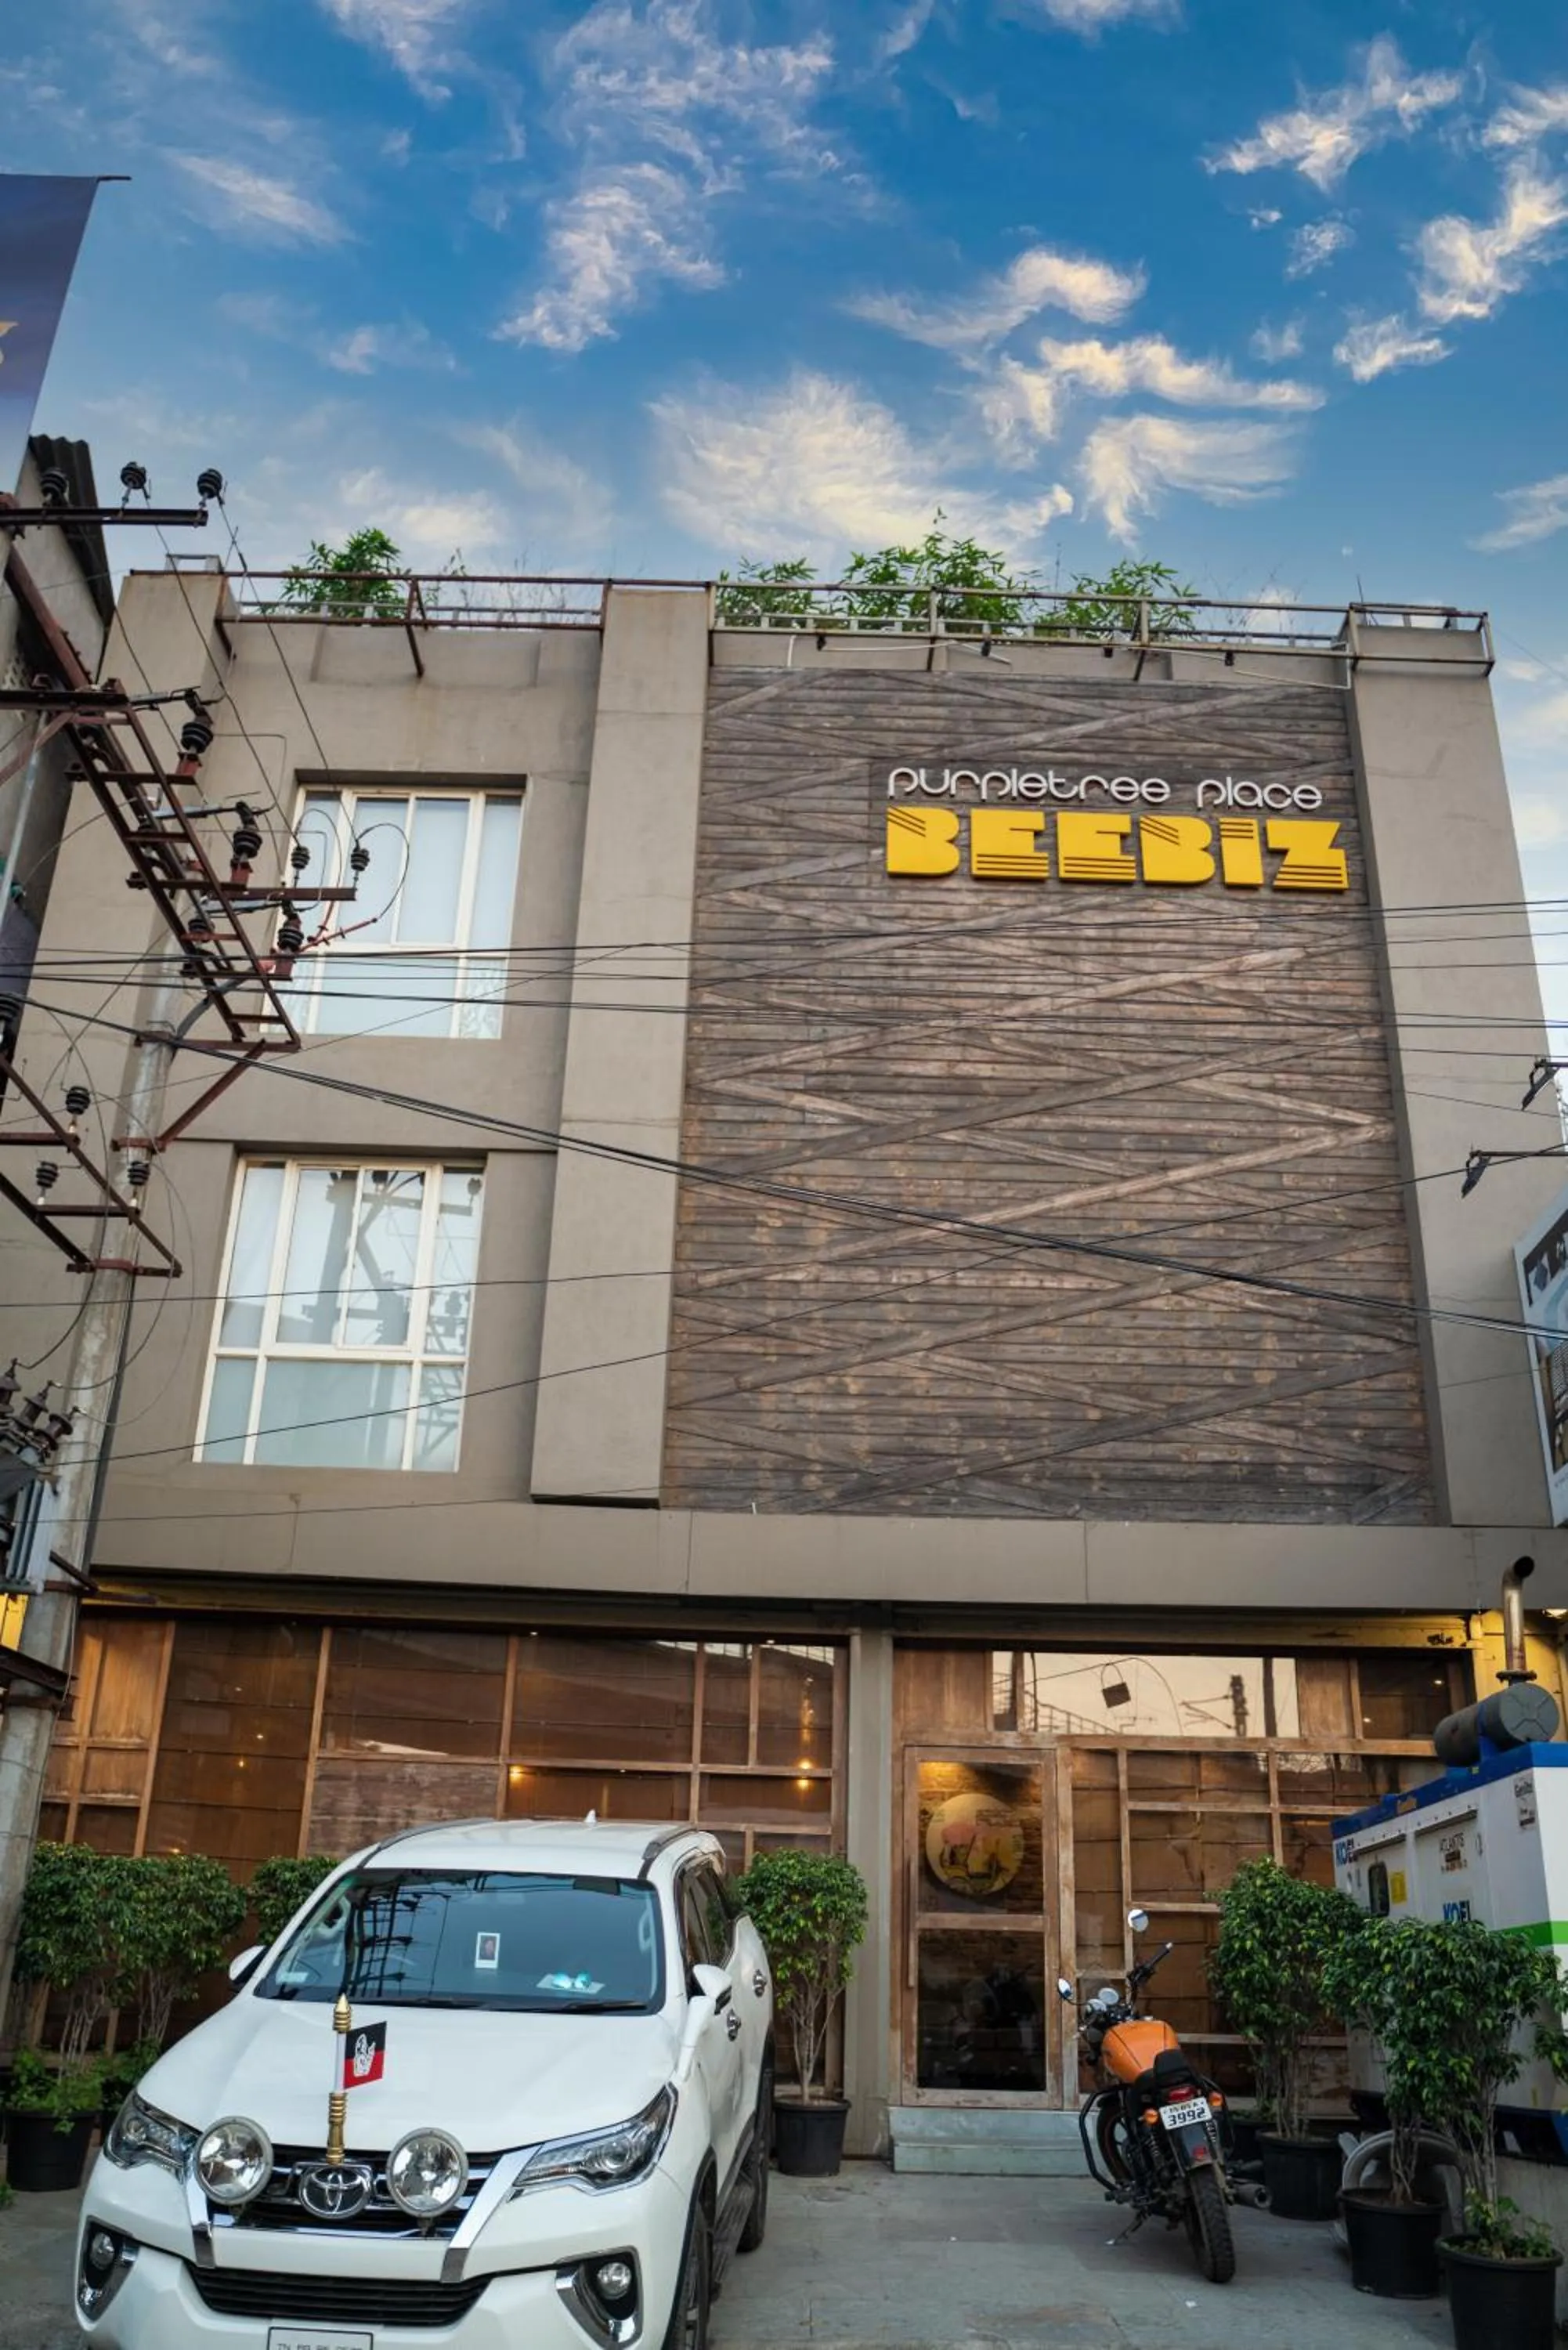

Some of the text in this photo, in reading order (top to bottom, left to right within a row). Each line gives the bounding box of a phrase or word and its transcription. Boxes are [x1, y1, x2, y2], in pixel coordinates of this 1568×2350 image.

[888, 767, 1323, 810] purpletree place
[1168, 2106, 1207, 2126] 3992
